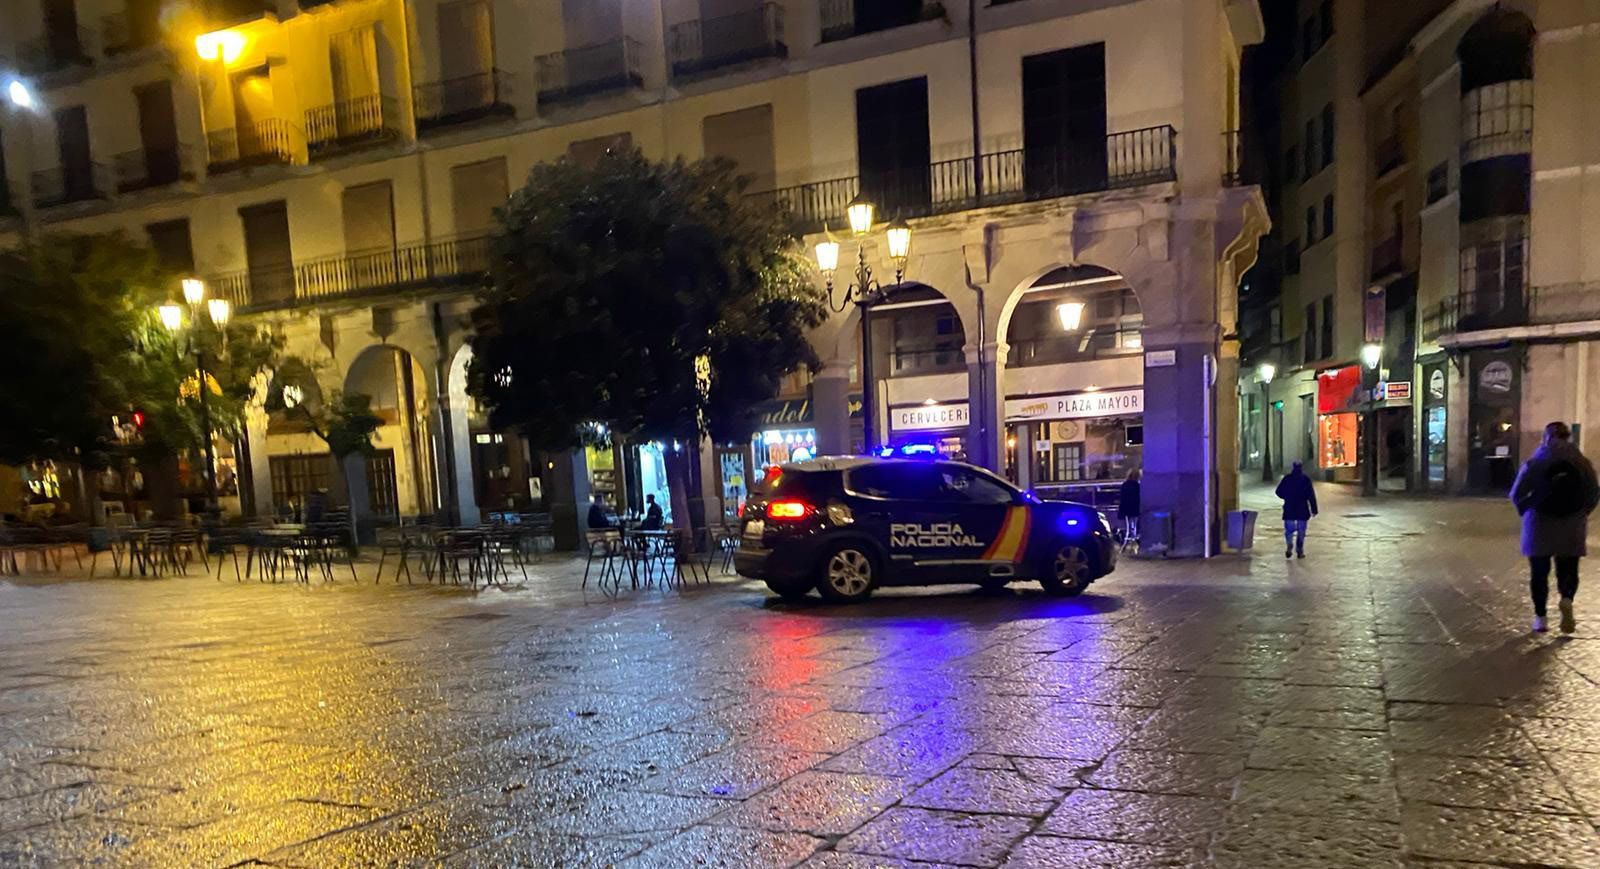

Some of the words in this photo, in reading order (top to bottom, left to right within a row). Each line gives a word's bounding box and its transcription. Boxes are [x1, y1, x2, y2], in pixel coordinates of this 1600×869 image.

[1058, 399, 1092, 413] PLAZA
[1098, 395, 1138, 410] MAYOR
[890, 535, 985, 547] NACIONAL
